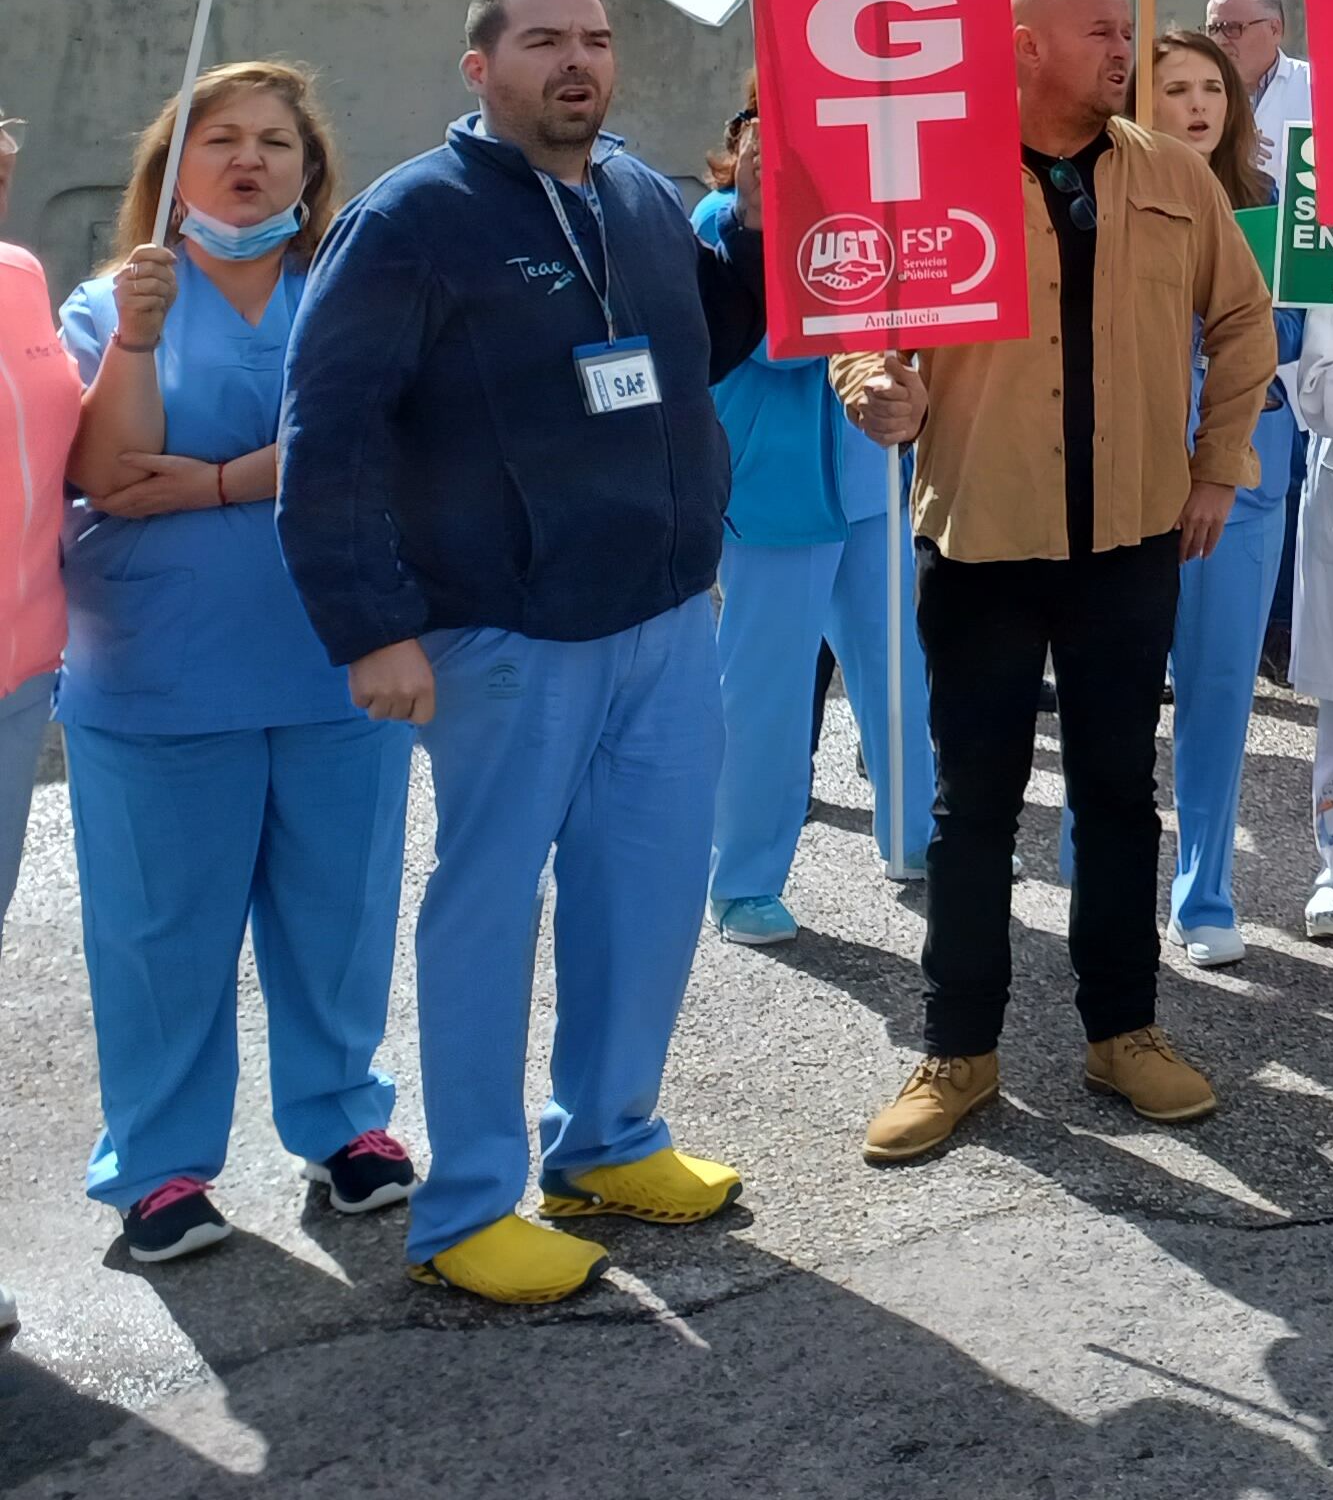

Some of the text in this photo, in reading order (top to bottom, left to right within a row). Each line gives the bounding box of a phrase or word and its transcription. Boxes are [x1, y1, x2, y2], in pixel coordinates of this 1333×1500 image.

[811, 227, 952, 268] UGT FSP
[903, 257, 947, 269] Servicios
[903, 268, 948, 281] Públicos
[865, 309, 940, 329] Andalucía
